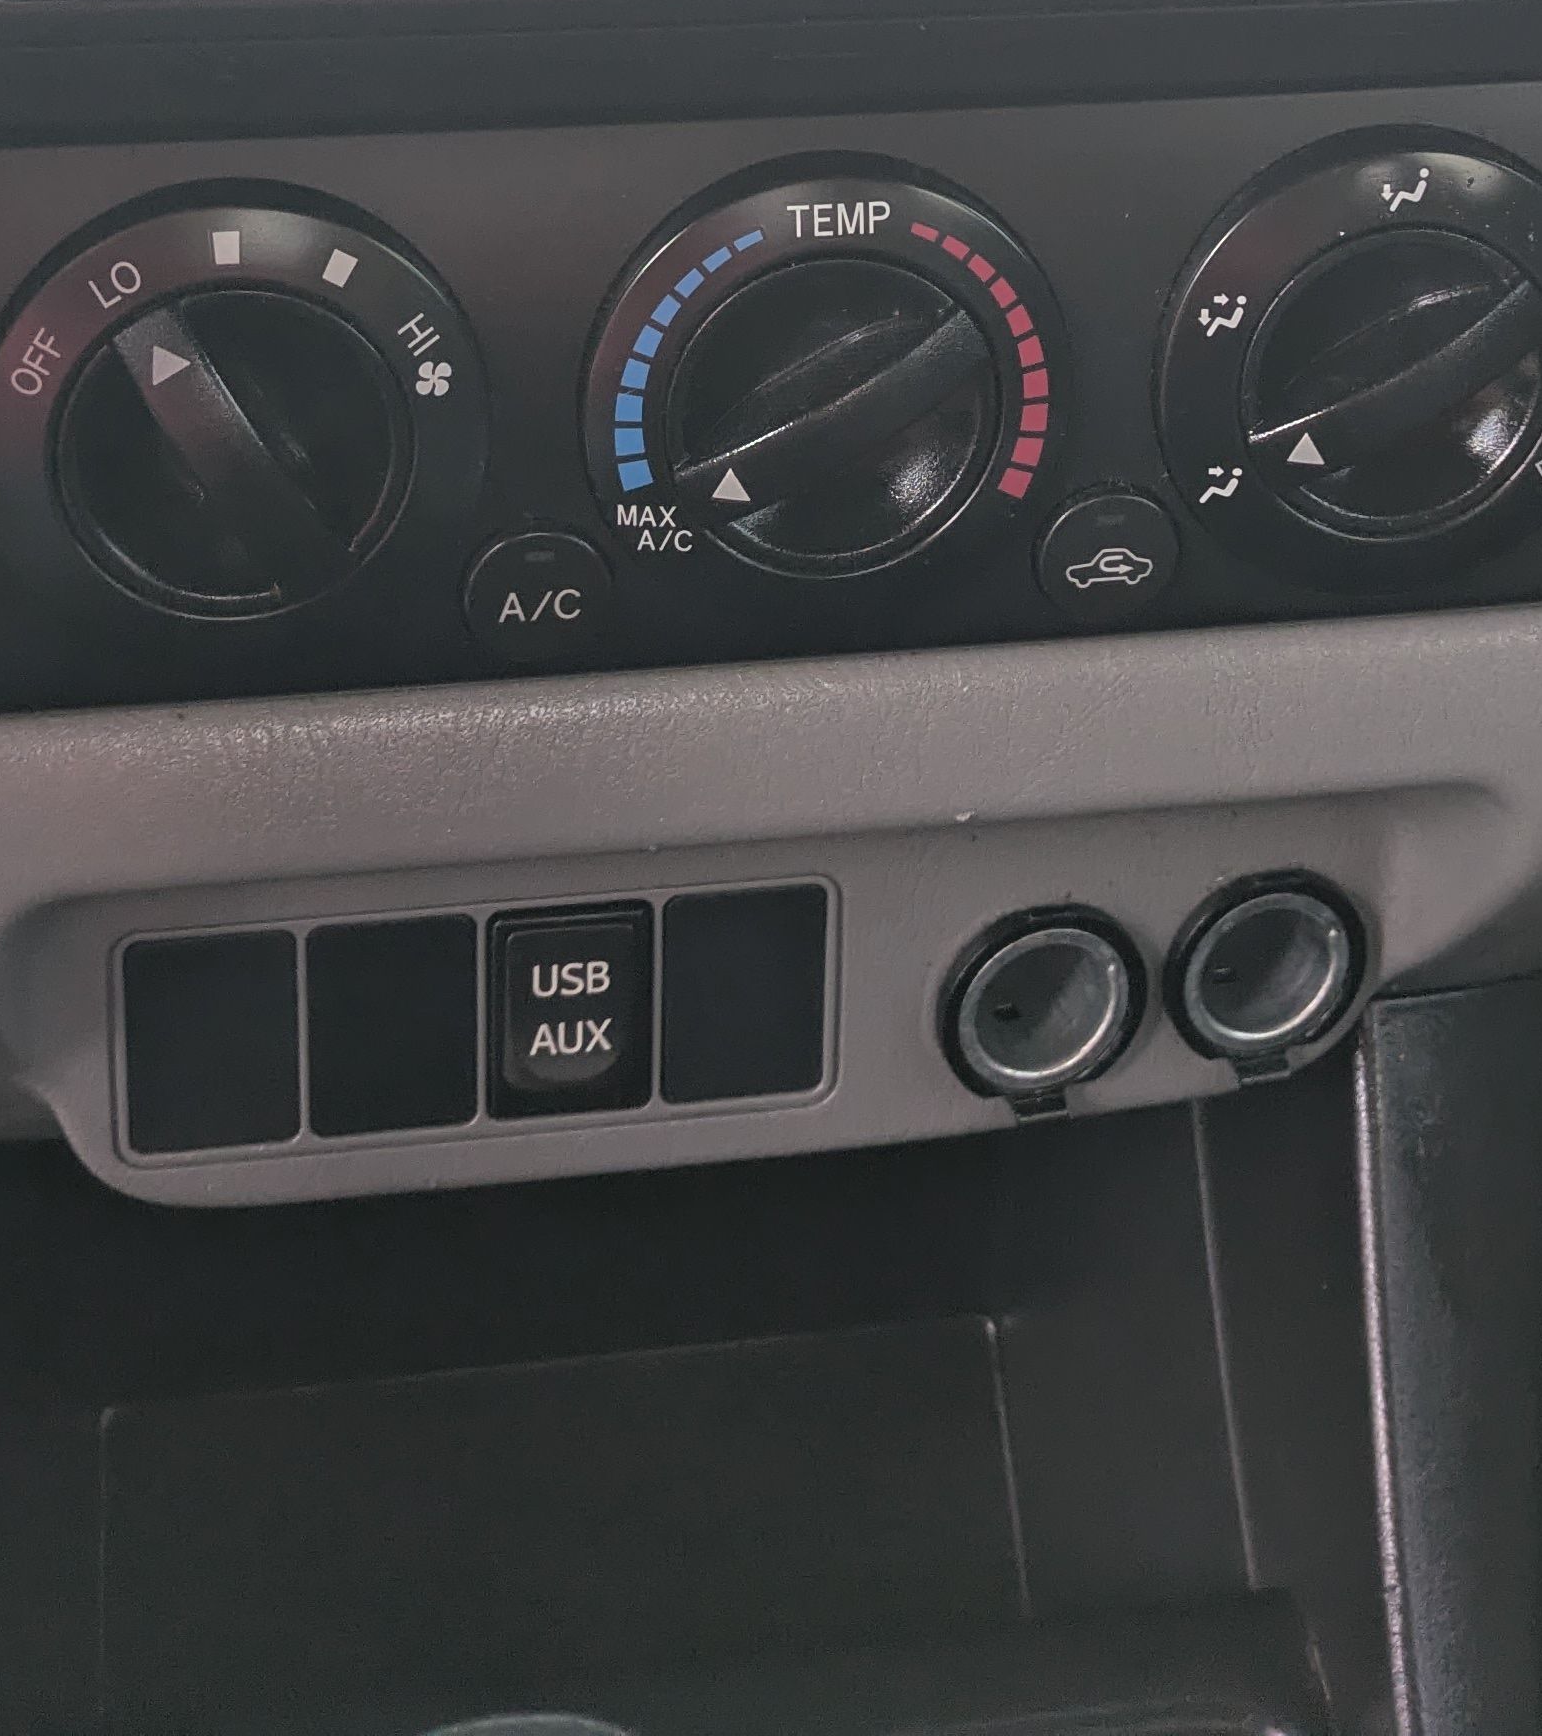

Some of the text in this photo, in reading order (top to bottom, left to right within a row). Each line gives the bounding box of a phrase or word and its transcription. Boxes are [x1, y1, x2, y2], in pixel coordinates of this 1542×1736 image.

[786, 200, 891, 238] TEMP
[88, 261, 141, 309] LO
[397, 312, 440, 357] HI
[11, 327, 61, 395] OFF
[616, 504, 677, 527] MAX
[637, 529, 693, 552] A/C
[498, 588, 582, 623] A/C
[532, 960, 611, 998] USB
[529, 1017, 612, 1057] AUX
